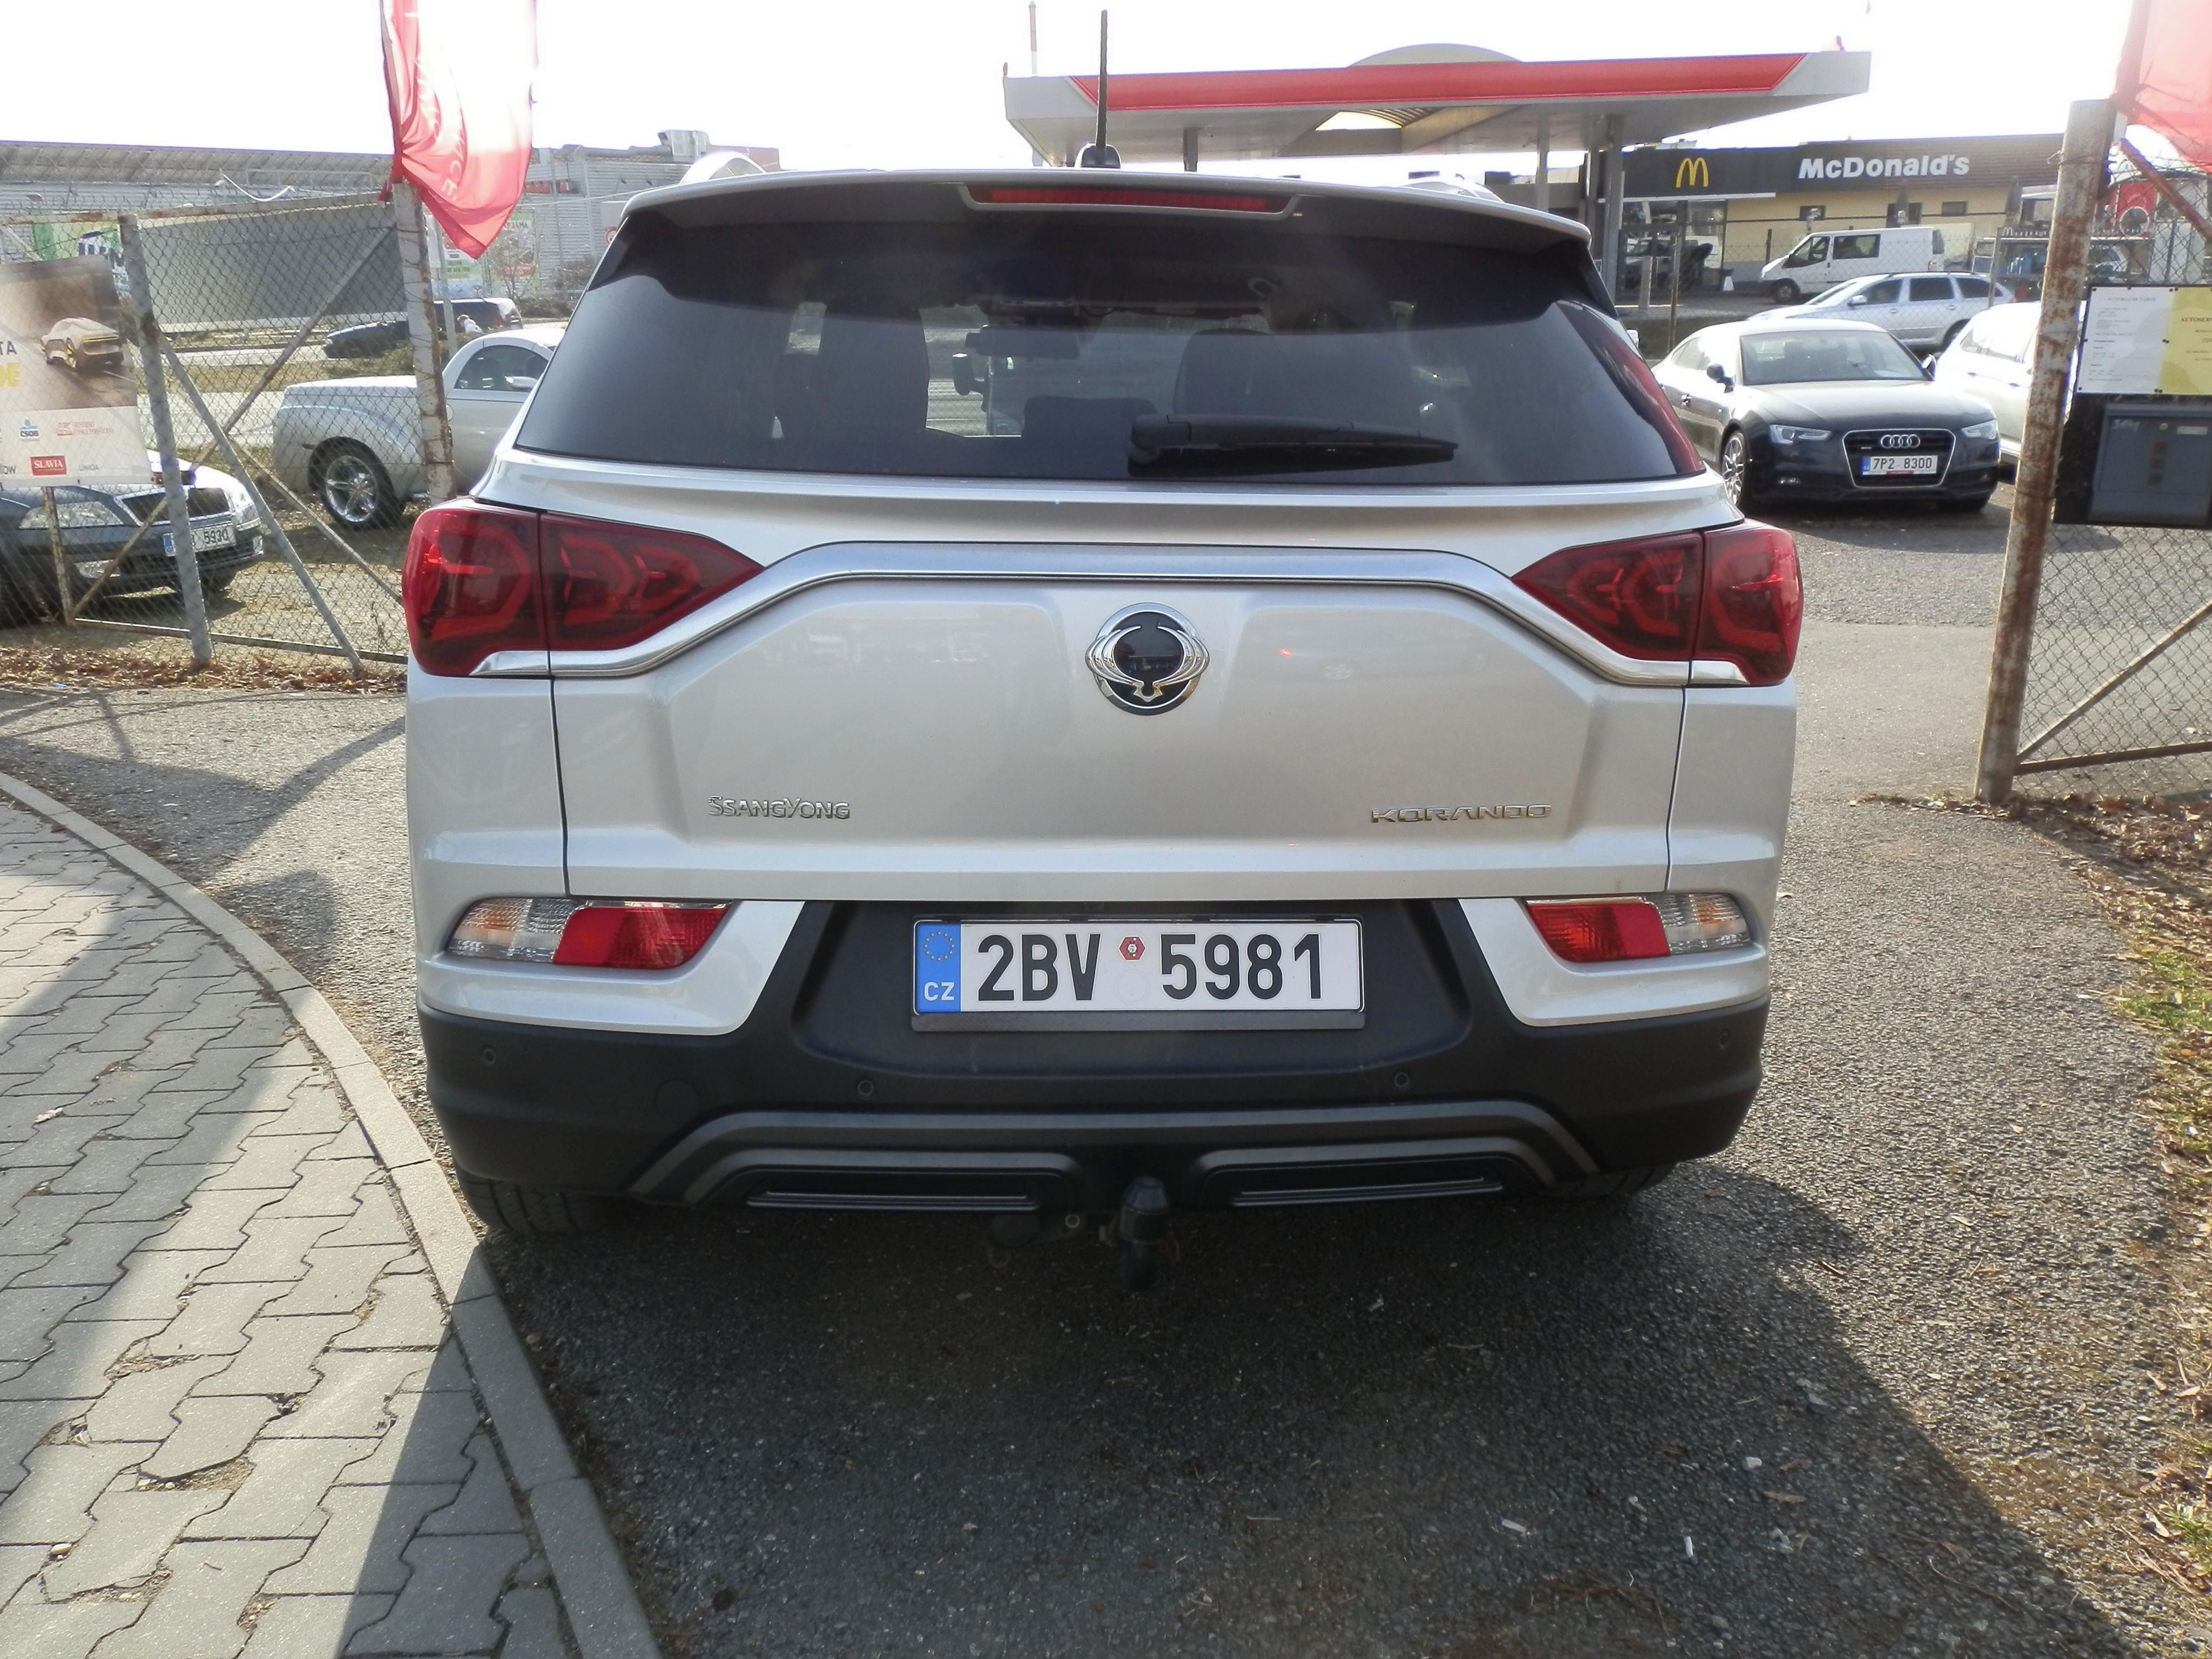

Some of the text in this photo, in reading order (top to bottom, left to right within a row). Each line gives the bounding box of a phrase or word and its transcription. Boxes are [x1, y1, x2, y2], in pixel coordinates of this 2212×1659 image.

[1798, 155, 1971, 179] McDonald's
[34, 459, 64, 469] SLAVIA
[1873, 457, 1932, 469] 7P2 8300
[203, 529, 229, 544] 5930
[1371, 804, 1552, 823] KORANDO
[977, 934, 1321, 1001] 2BV 5981
[923, 981, 955, 1001] CZ
